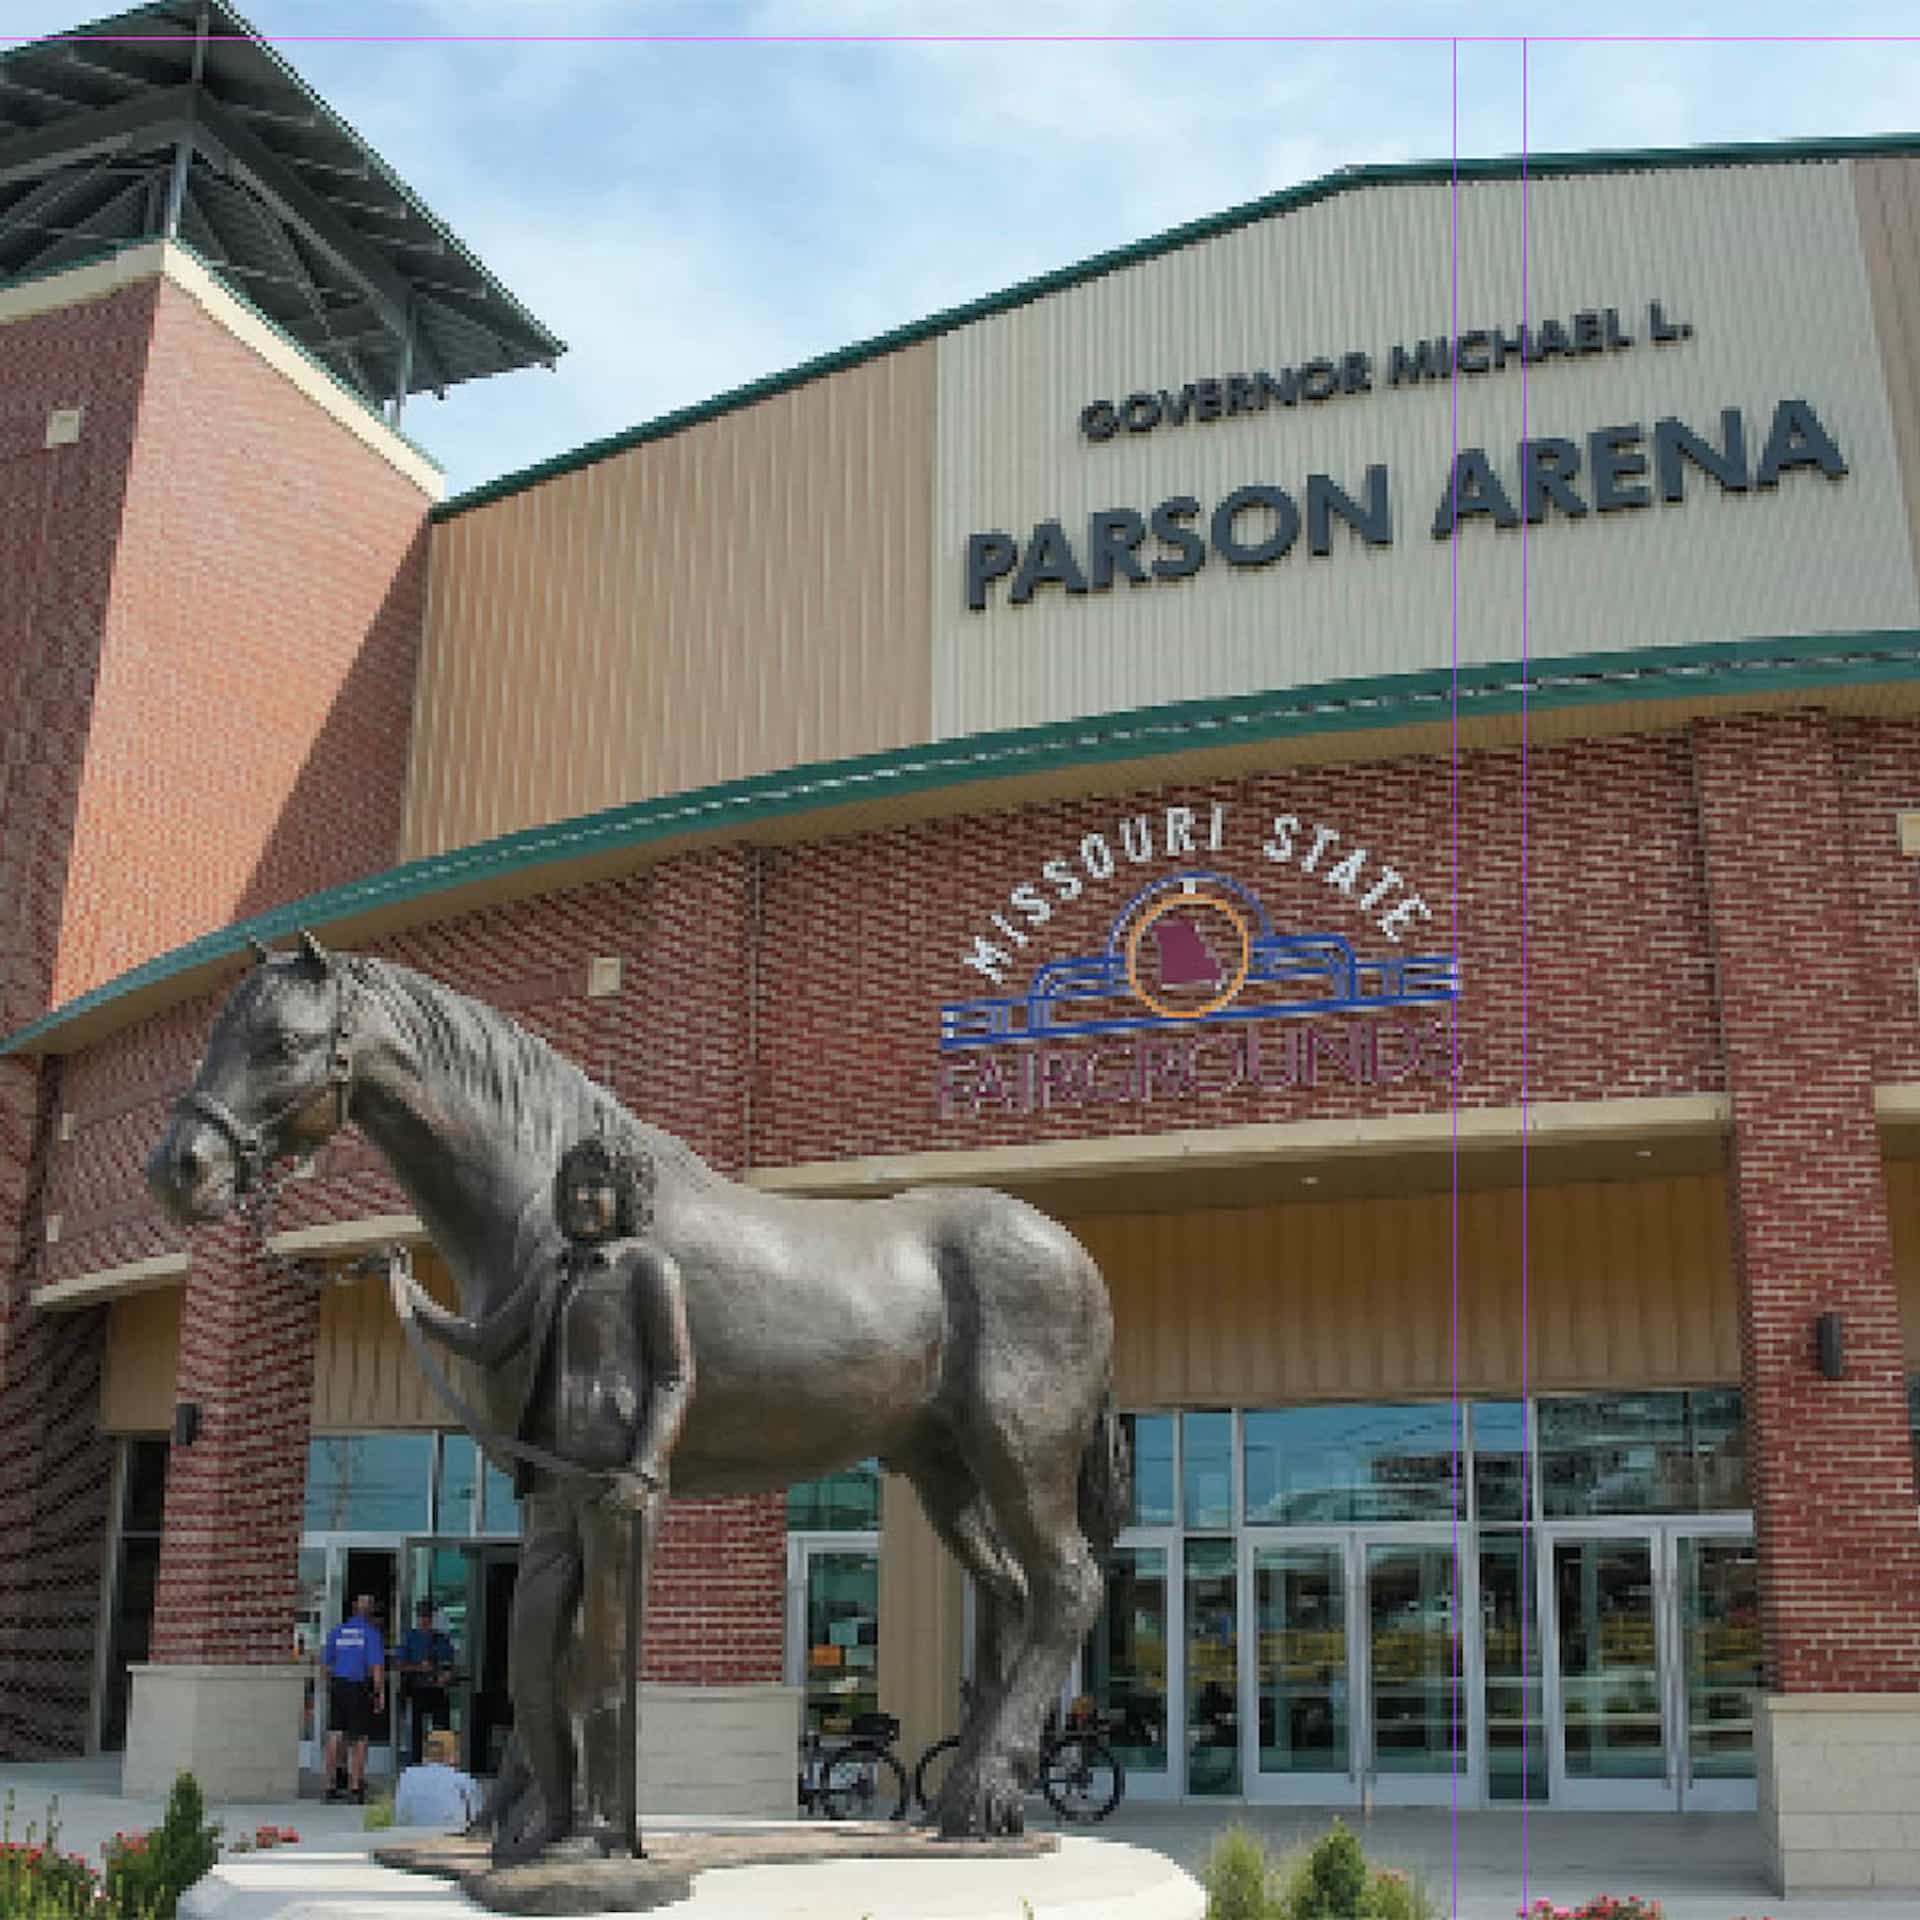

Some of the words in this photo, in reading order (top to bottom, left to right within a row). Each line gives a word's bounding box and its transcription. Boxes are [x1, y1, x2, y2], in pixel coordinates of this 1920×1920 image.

[1080, 352, 1372, 441] GOVERNOR
[1387, 306, 1632, 387] MICHAEL
[1648, 299, 1693, 342] L.
[966, 464, 1391, 612] PARSON
[1431, 400, 1848, 541] ARENA
[963, 806, 1224, 984] MISSOURI
[1263, 815, 1432, 942] STATE
[939, 1016, 1464, 1120] FAIRGROUNDS
